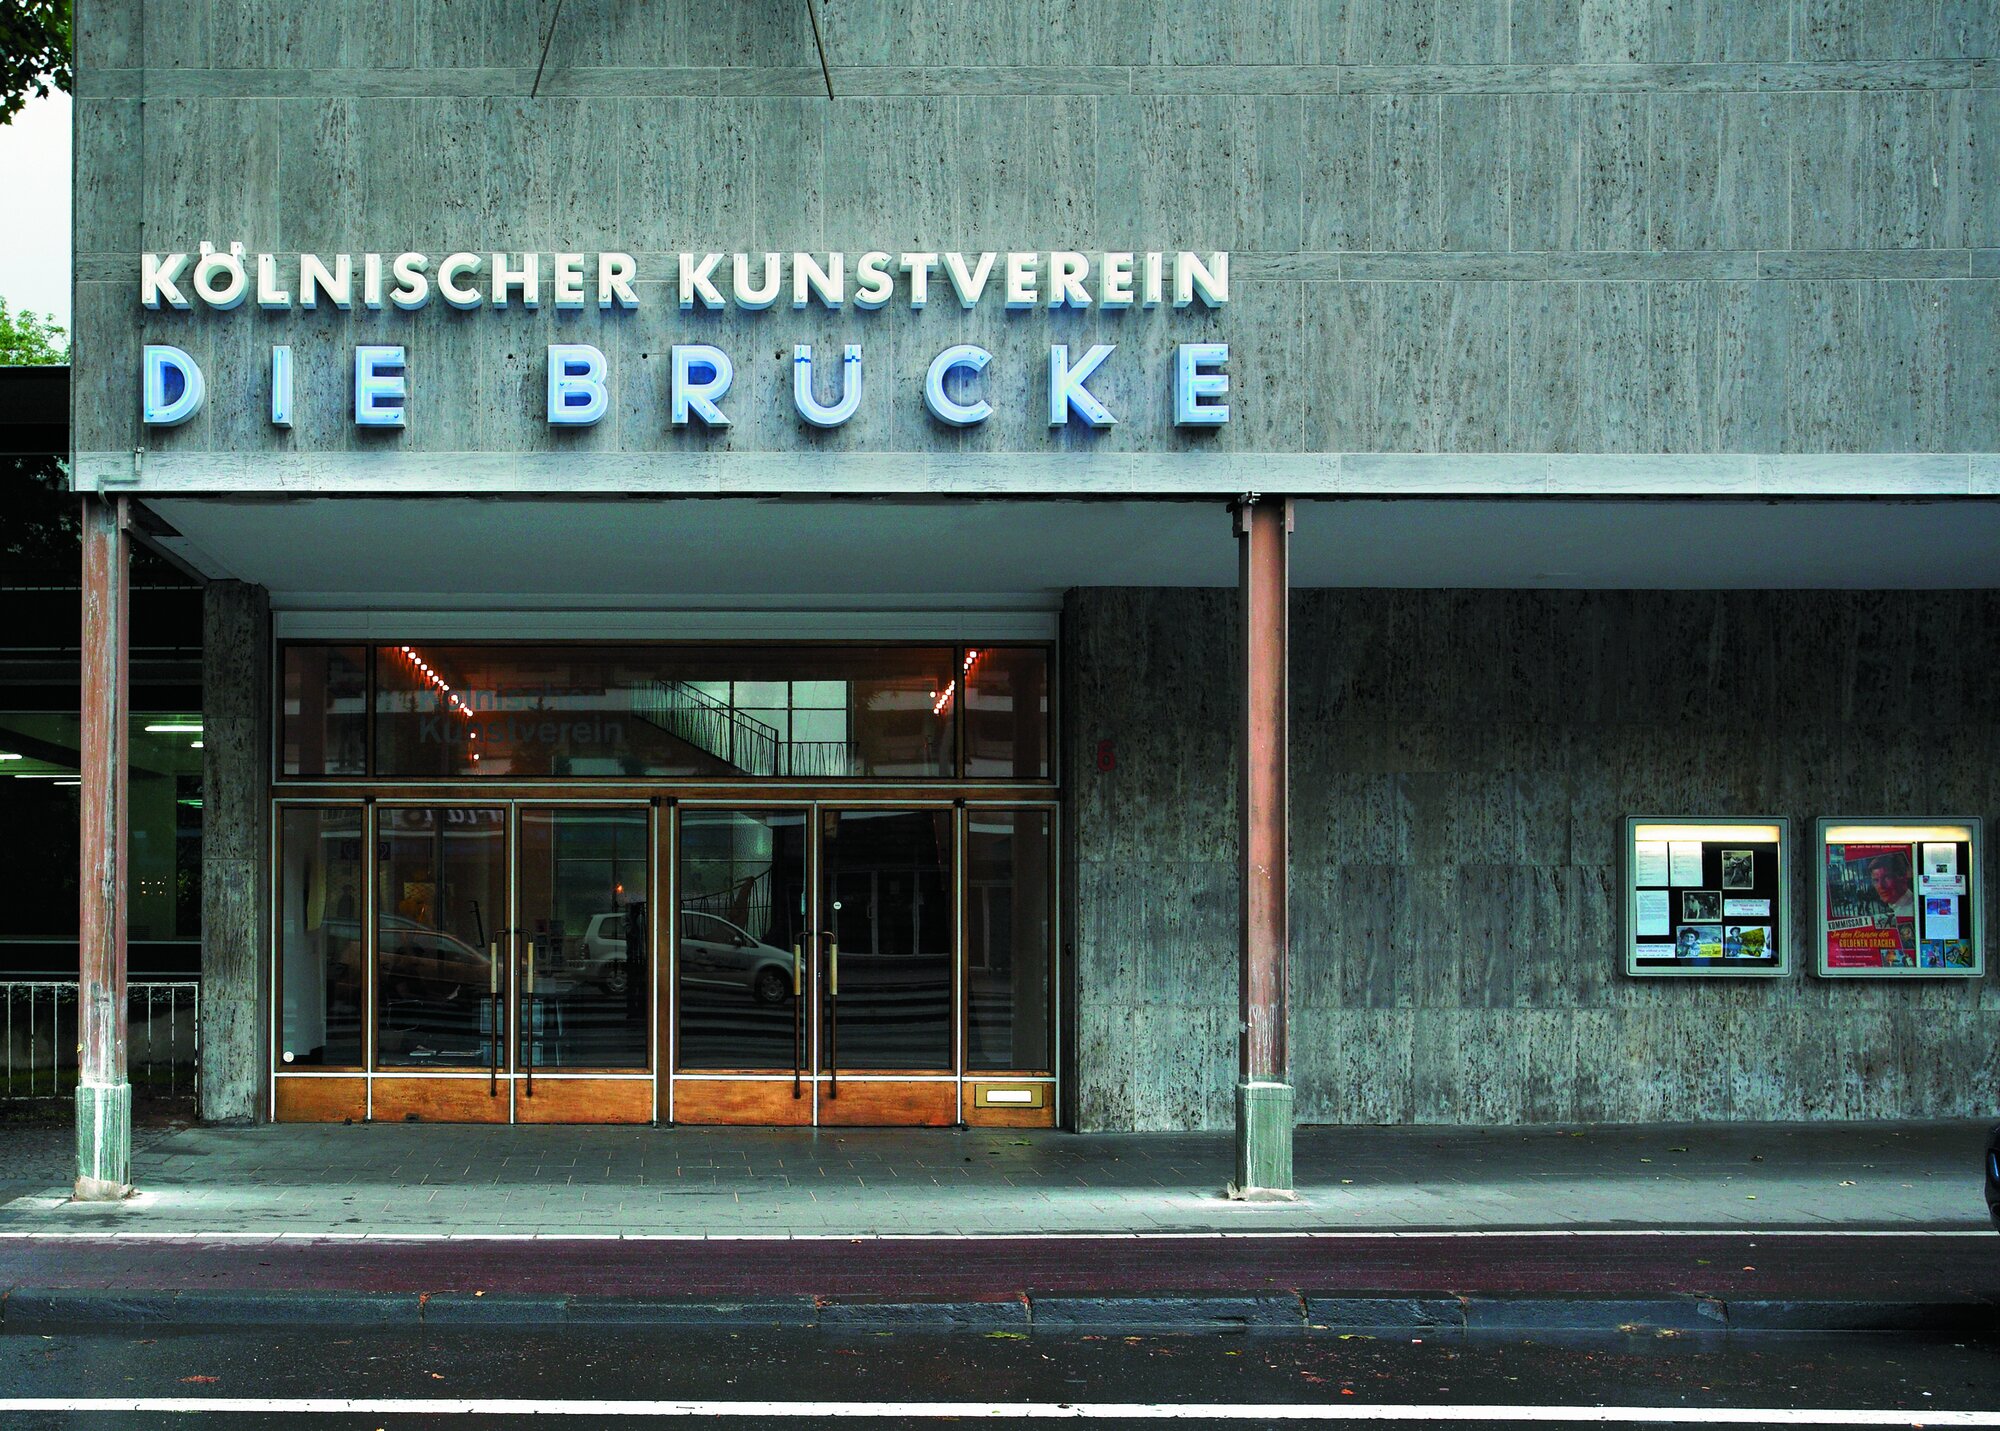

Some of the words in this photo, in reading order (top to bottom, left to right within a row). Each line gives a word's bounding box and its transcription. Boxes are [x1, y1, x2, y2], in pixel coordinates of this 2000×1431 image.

[142, 241, 639, 311] KÖLNISCHER
[679, 251, 1229, 311] KUNSTVEREIN
[143, 344, 407, 429] DIE
[547, 343, 1231, 429] BRÜCKE
[1097, 739, 1116, 771] 6
